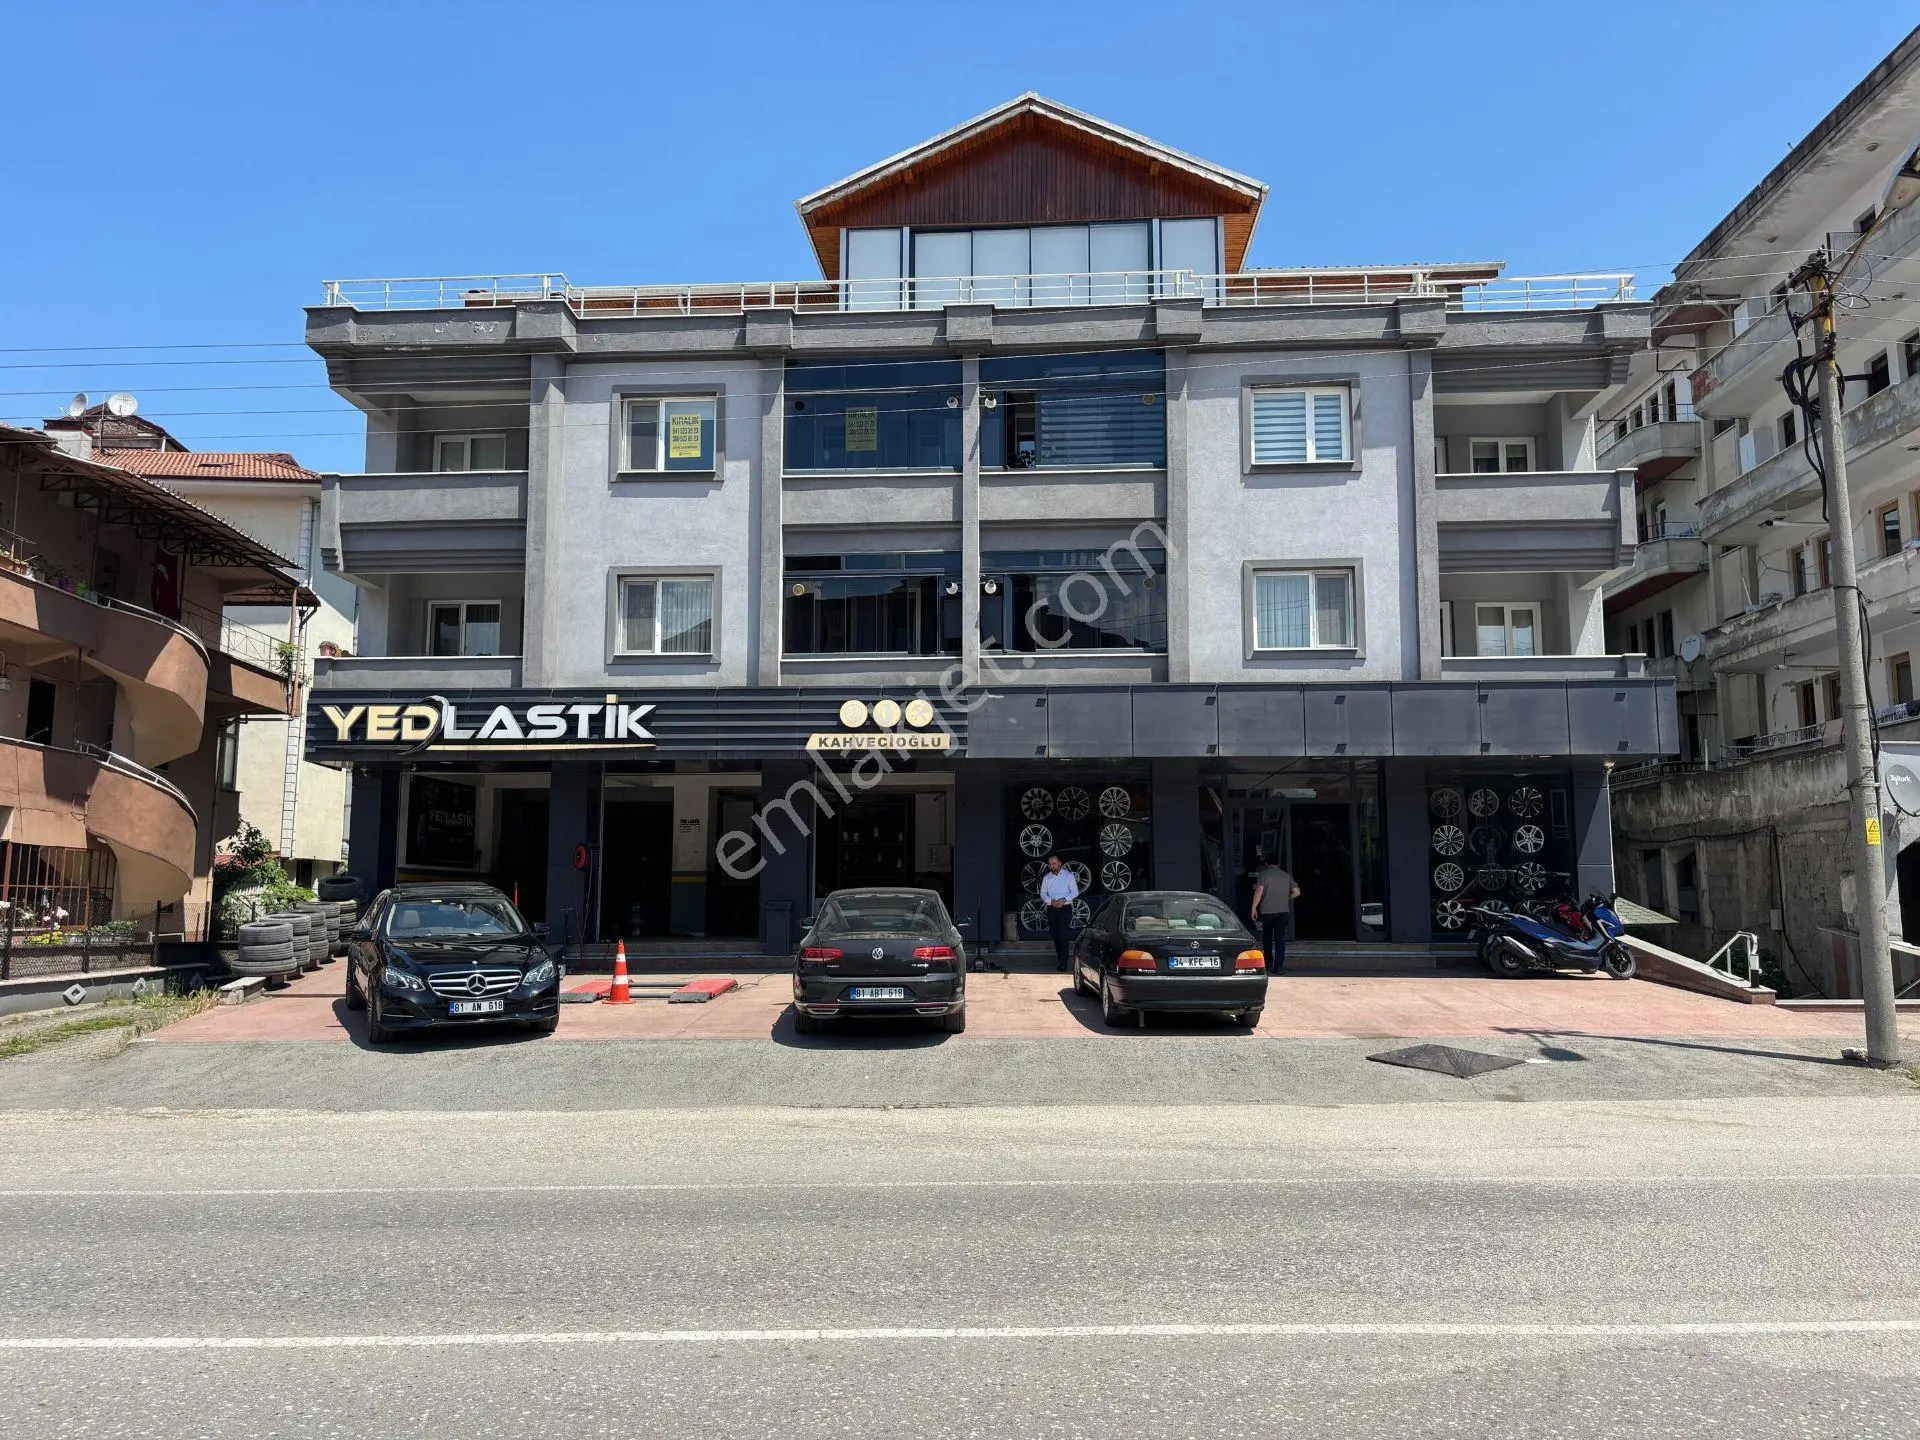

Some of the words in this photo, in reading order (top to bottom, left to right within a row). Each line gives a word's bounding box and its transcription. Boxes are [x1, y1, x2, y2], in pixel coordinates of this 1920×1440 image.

[818, 735, 942, 748] KAHVECİOĞLU
[454, 1003, 464, 1013] 81
[472, 1002, 482, 1012] AN
[488, 1000, 503, 1011] 618
